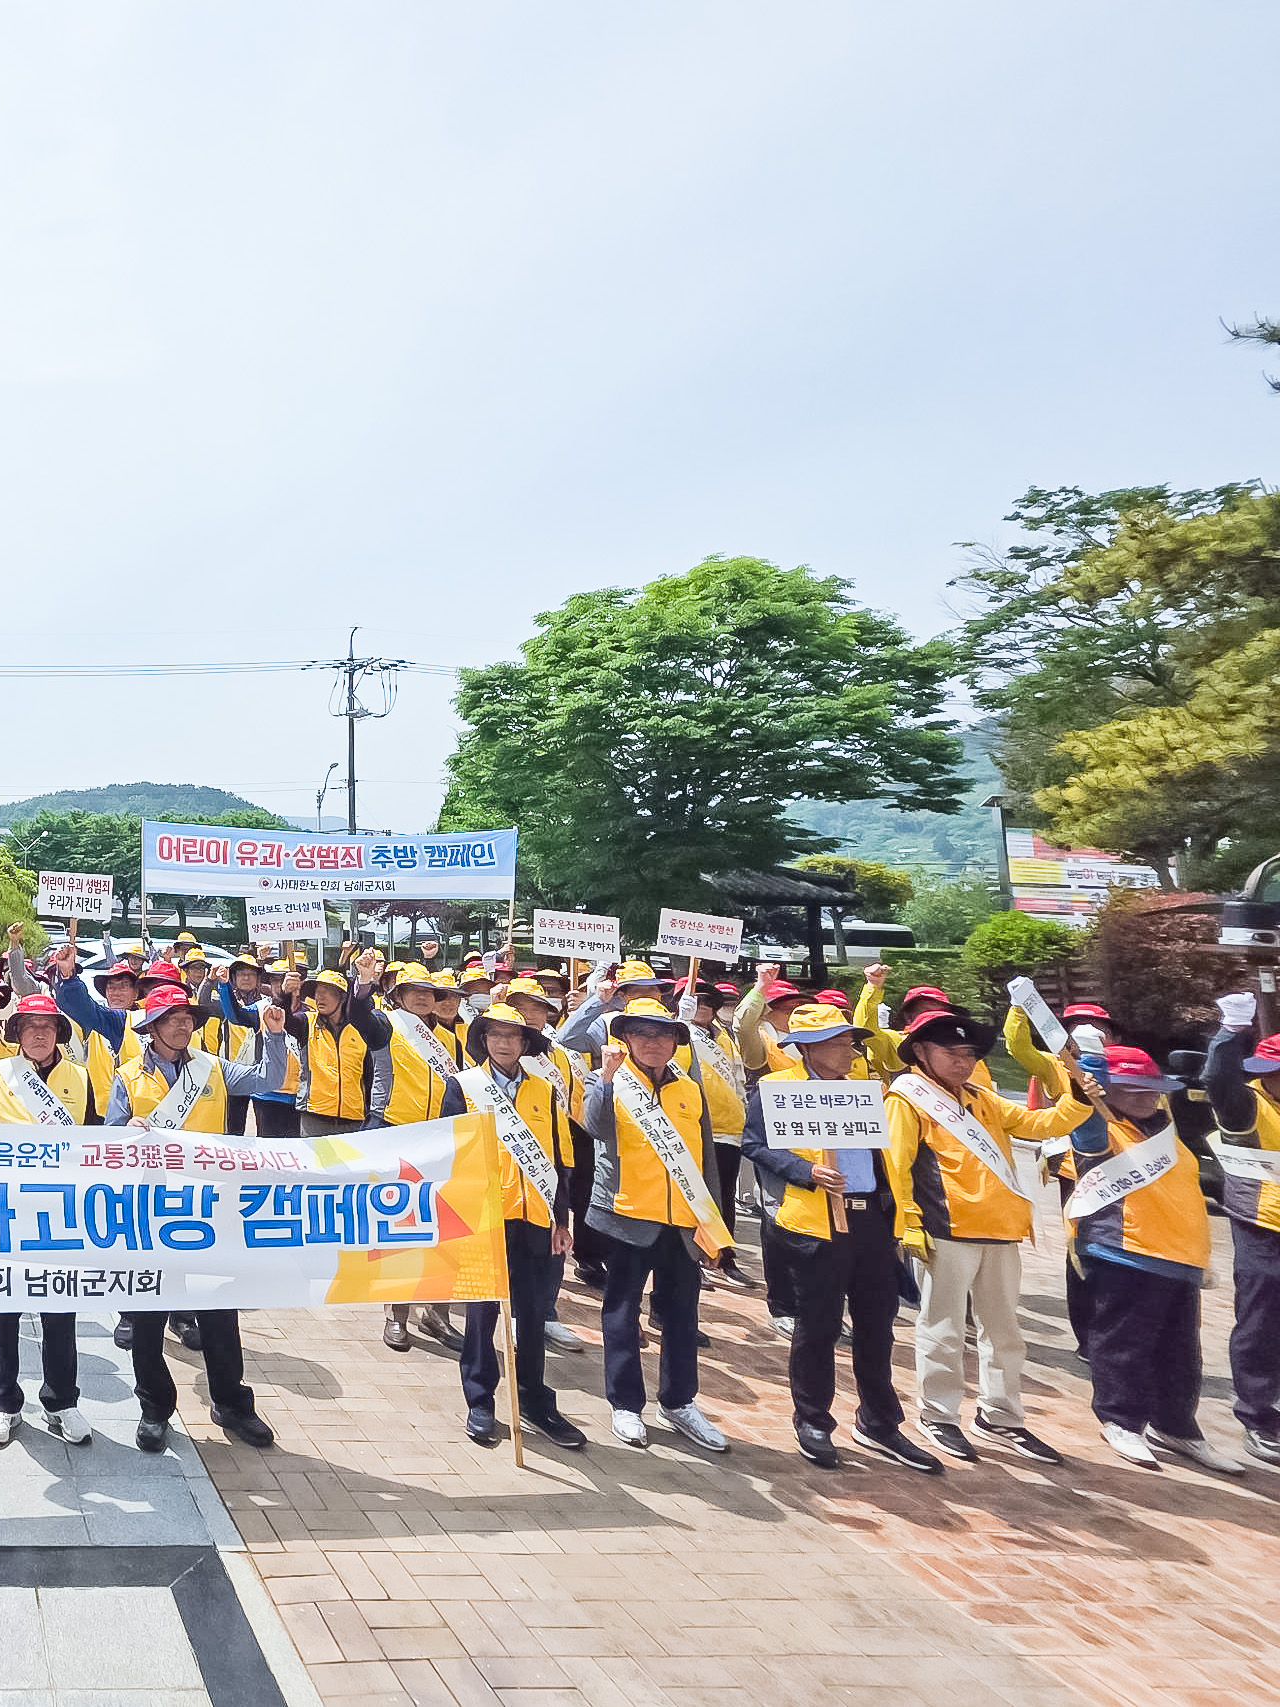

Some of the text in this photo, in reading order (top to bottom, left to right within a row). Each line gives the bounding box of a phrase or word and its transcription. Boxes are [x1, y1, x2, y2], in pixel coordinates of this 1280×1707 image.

[157, 834, 496, 870] 어린이 유괴·성범죄 추방 캠페인
[41, 875, 111, 896] 어린이 유괴 성범죄
[343, 880, 396, 893] 남해군지회
[47, 894, 103, 914] 우리가 지킨다
[249, 904, 283, 916] 횡단보도
[311, 901, 322, 911] 때
[251, 920, 322, 934] 양쪽모두 살피세요
[538, 918, 615, 934] 음주운전 퇴치하고
[669, 917, 734, 936] 중앙선은 생명선
[538, 935, 616, 952] 교통범죄 추방하자
[703, 940, 739, 954] 사고예방
[21, 1070, 55, 1108] 교통법규
[772, 1093, 874, 1109] 갈 길은 바로가고
[654, 1116, 678, 1141] 가는
[671, 1142, 687, 1155] 길
[773, 1121, 882, 1136] 앞 옆 뒤 잘 살피고
[502, 1132, 540, 1178] 아름다운
[631, 1109, 696, 1202] 교통질서가 첫걸음
[966, 1128, 1002, 1166] 우리가
[238, 1180, 435, 1250] 캠페인
[24, 1267, 164, 1298] 남해군지회
